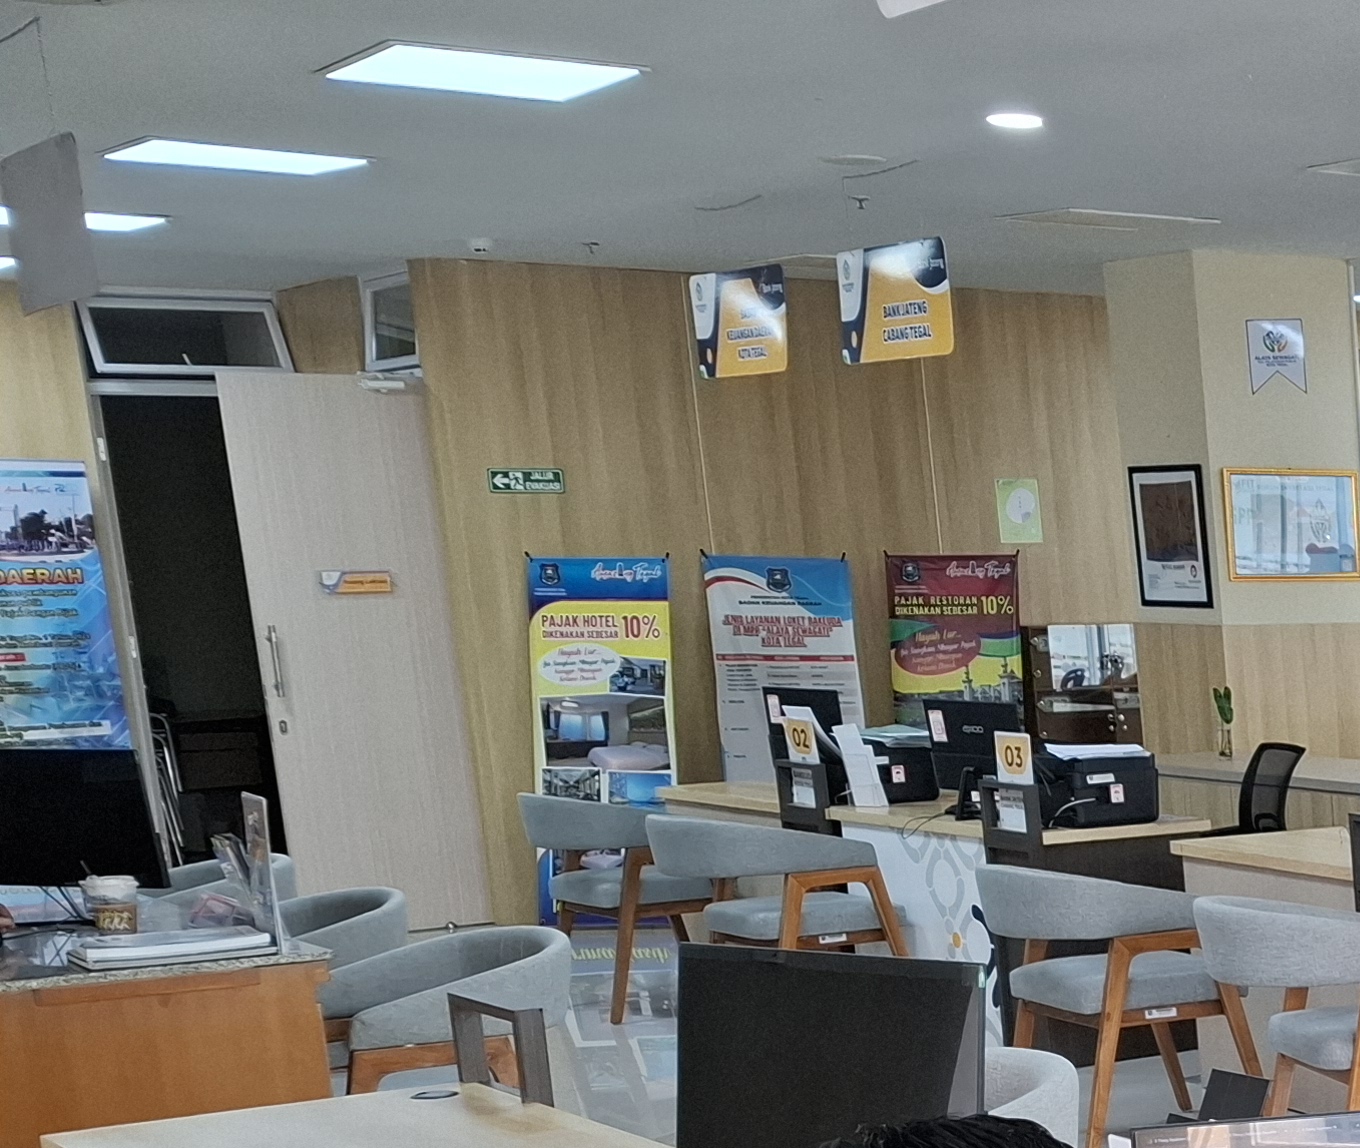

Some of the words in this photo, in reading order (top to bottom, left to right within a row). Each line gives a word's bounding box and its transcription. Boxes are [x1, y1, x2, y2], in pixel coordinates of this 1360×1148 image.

[883, 303, 901, 319] BANK
[901, 301, 928, 317] JATENG
[883, 326, 909, 342] CABANG
[909, 325, 932, 340] TEGAL
[530, 472, 554, 480] JALUR
[895, 596, 924, 604] PAJAK
[931, 596, 978, 604] RESTORAN
[981, 595, 1014, 614] 10%
[895, 606, 940, 615] DIKENAKAN
[943, 606, 978, 615] SEBESAR
[542, 615, 579, 627] PAJAK
[582, 615, 618, 627] HOTEL
[622, 615, 660, 638] 10%
[746, 615, 782, 626] LAYANAN
[542, 630, 585, 638] DIKENAKAN
[587, 630, 619, 638] SEBESAR
[761, 637, 782, 648] KOTA
[792, 728, 809, 747] 02
[1005, 744, 1024, 768] 03
